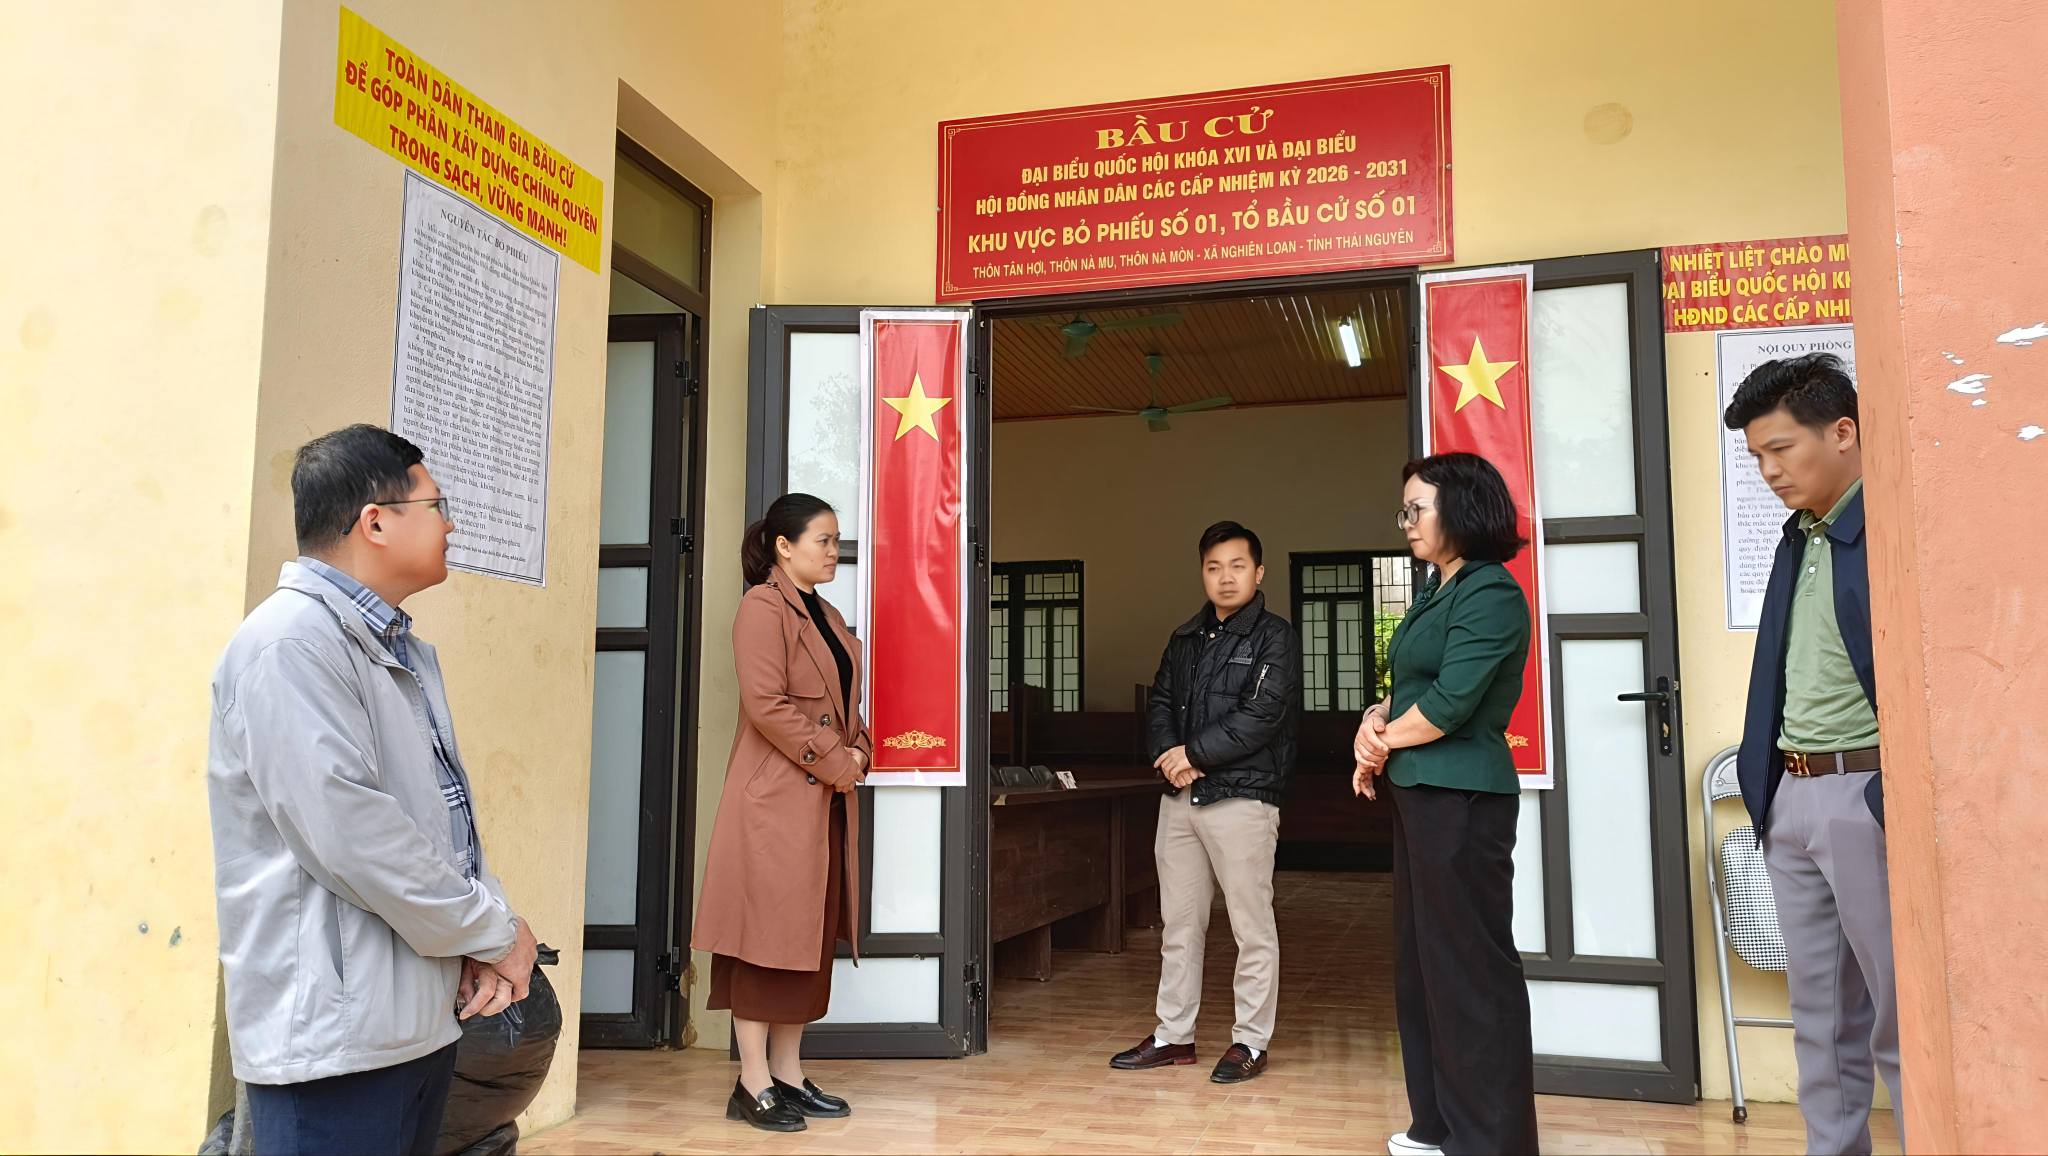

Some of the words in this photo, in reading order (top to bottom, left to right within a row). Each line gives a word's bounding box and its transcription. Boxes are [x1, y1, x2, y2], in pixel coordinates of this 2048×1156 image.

[386, 48, 427, 95] TOÀN
[432, 80, 462, 115] DÂN
[467, 103, 505, 144] THAM
[509, 132, 529, 160] GIA
[533, 145, 557, 177] BẦU
[560, 163, 575, 189] CỬ
[1096, 115, 1189, 149] BẦU
[1204, 106, 1274, 137] CỬ
[345, 59, 368, 92] ĐỂ
[371, 78, 402, 112] GÓP
[407, 99, 447, 143] PHẦN
[452, 128, 479, 160] XÂY
[482, 147, 519, 186] DỰNG
[523, 173, 559, 210] CHÍNH
[562, 199, 598, 235] QUYỀN
[1022, 167, 1048, 186] ĐẠI
[1053, 157, 1088, 181] BIỂU
[1094, 153, 1136, 178] QUỐC
[1142, 152, 1168, 174] HỘI
[1175, 147, 1218, 169] KHÓA
[1224, 146, 1250, 164] XVI
[1256, 140, 1277, 160] VÀ
[1283, 139, 1311, 160] ĐẠI
[1317, 130, 1357, 154] BIỂU
[390, 125, 439, 174] TRONG
[444, 159, 482, 202] SẠCH,
[488, 185, 523, 222] VỮNG
[528, 207, 566, 245] MẠNH!
[976, 195, 1001, 217] HỘI
[1006, 190, 1049, 212] ĐỒNG
[1055, 187, 1098, 208] NHÂN
[1104, 183, 1137, 203] DÂN
[1143, 179, 1175, 199] CÁC
[1181, 173, 1213, 196] CẤP
[1219, 170, 1274, 193] NHIỆM
[1280, 166, 1301, 186] KỲ
[1307, 165, 1349, 184] 2026
[1365, 160, 1406, 180] 2031
[969, 233, 1007, 253] KHU
[1014, 227, 1056, 253] VỰC
[1063, 219, 1090, 245] BỎ
[1098, 212, 1153, 242] PHIẾU
[1161, 208, 1188, 236] SỐ
[1195, 214, 1225, 235] 01,
[1232, 199, 1261, 230] TỔ
[1266, 196, 1310, 229] BẦU
[1317, 194, 1349, 225] CỬ
[1354, 189, 1386, 221] SỐ
[1391, 194, 1416, 217] 01
[973, 263, 1000, 278] THÔN
[1003, 261, 1023, 276] TÂN
[1027, 260, 1046, 276] HỢI,
[1049, 257, 1077, 272] THÔN
[1081, 255, 1095, 270] NÀ
[1098, 256, 1116, 269] MU,
[1120, 251, 1148, 267] THÔN
[1152, 248, 1166, 264] NÀ
[1170, 247, 1195, 263] MÒN
[1204, 244, 1218, 260] XÃ
[1221, 242, 1264, 259] NGHIÊN
[1266, 241, 1297, 256] LOAN
[1306, 235, 1334, 252] TỈNH
[1336, 233, 1362, 250] THÁI
[1364, 228, 1414, 247] NGUYÊN
[1670, 248, 1725, 274] NHIỆT
[1729, 245, 1765, 271] LIỆT
[1770, 242, 1823, 266] CHÀO
[1828, 243, 1850, 262] M
[1691, 271, 1730, 297] BIỂU
[1736, 269, 1787, 297] QUỐC
[1793, 267, 1827, 295] HỘI
[1674, 307, 1728, 326] HĐND
[1733, 300, 1768, 323] CÁC
[1773, 295, 1809, 321] CẤP
[1816, 299, 1851, 318] NHI
[1758, 344, 1779, 355] NỘI
[1782, 343, 1807, 353] QUY
[1810, 340, 1852, 351] PHÒNG
